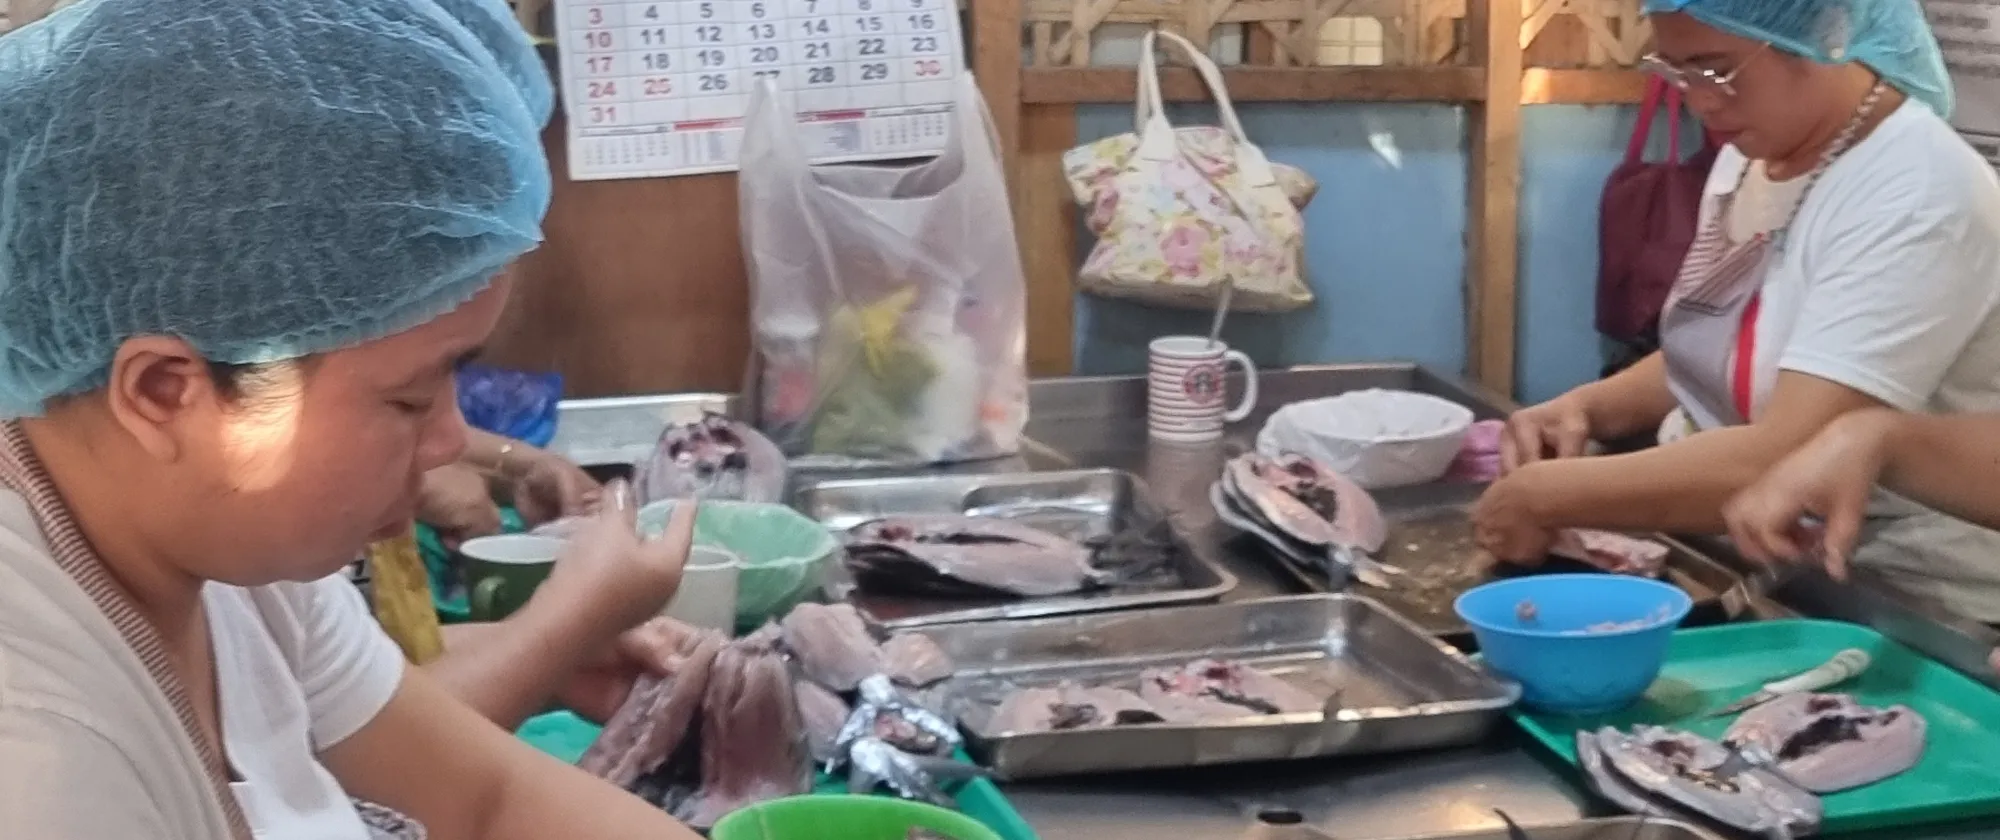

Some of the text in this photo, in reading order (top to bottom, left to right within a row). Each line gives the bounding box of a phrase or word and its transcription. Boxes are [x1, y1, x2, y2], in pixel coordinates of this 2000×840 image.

[589, 8, 602, 24] 3
[645, 5, 658, 19] 4
[701, 3, 713, 18] 5
[752, 3, 765, 18] 6
[804, 0, 818, 13] 7
[585, 14, 934, 48] 10 11 12 13 14 15 16
[586, 37, 937, 73] 17 18 19 20 21 22 23
[588, 60, 941, 98] 24 25 26 28 29 30
[590, 107, 616, 123] 31
